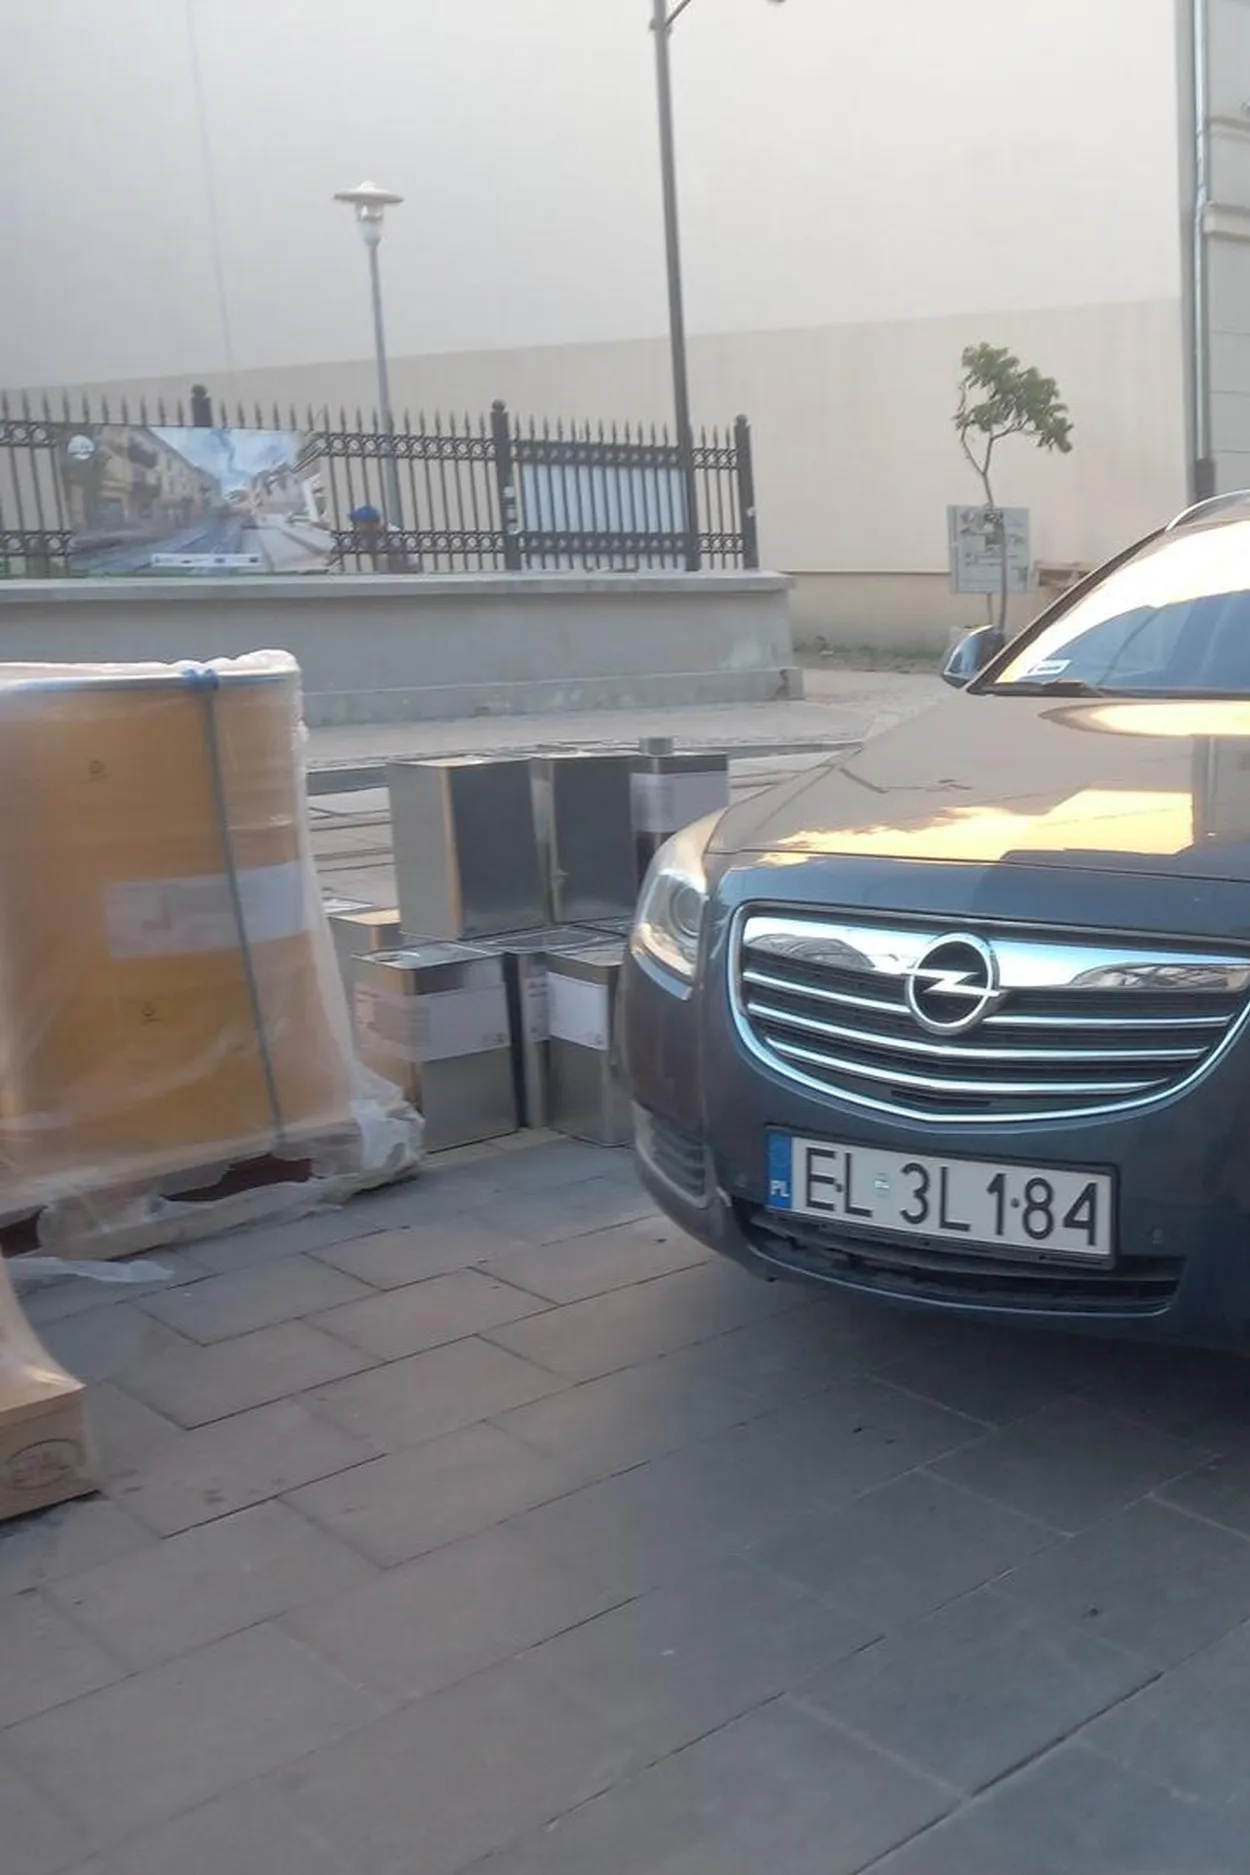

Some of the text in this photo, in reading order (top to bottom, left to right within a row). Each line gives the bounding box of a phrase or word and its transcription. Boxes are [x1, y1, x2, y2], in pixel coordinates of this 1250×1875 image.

[769, 1179, 790, 1198] PL
[806, 1147, 1097, 1246] EL 3L184
